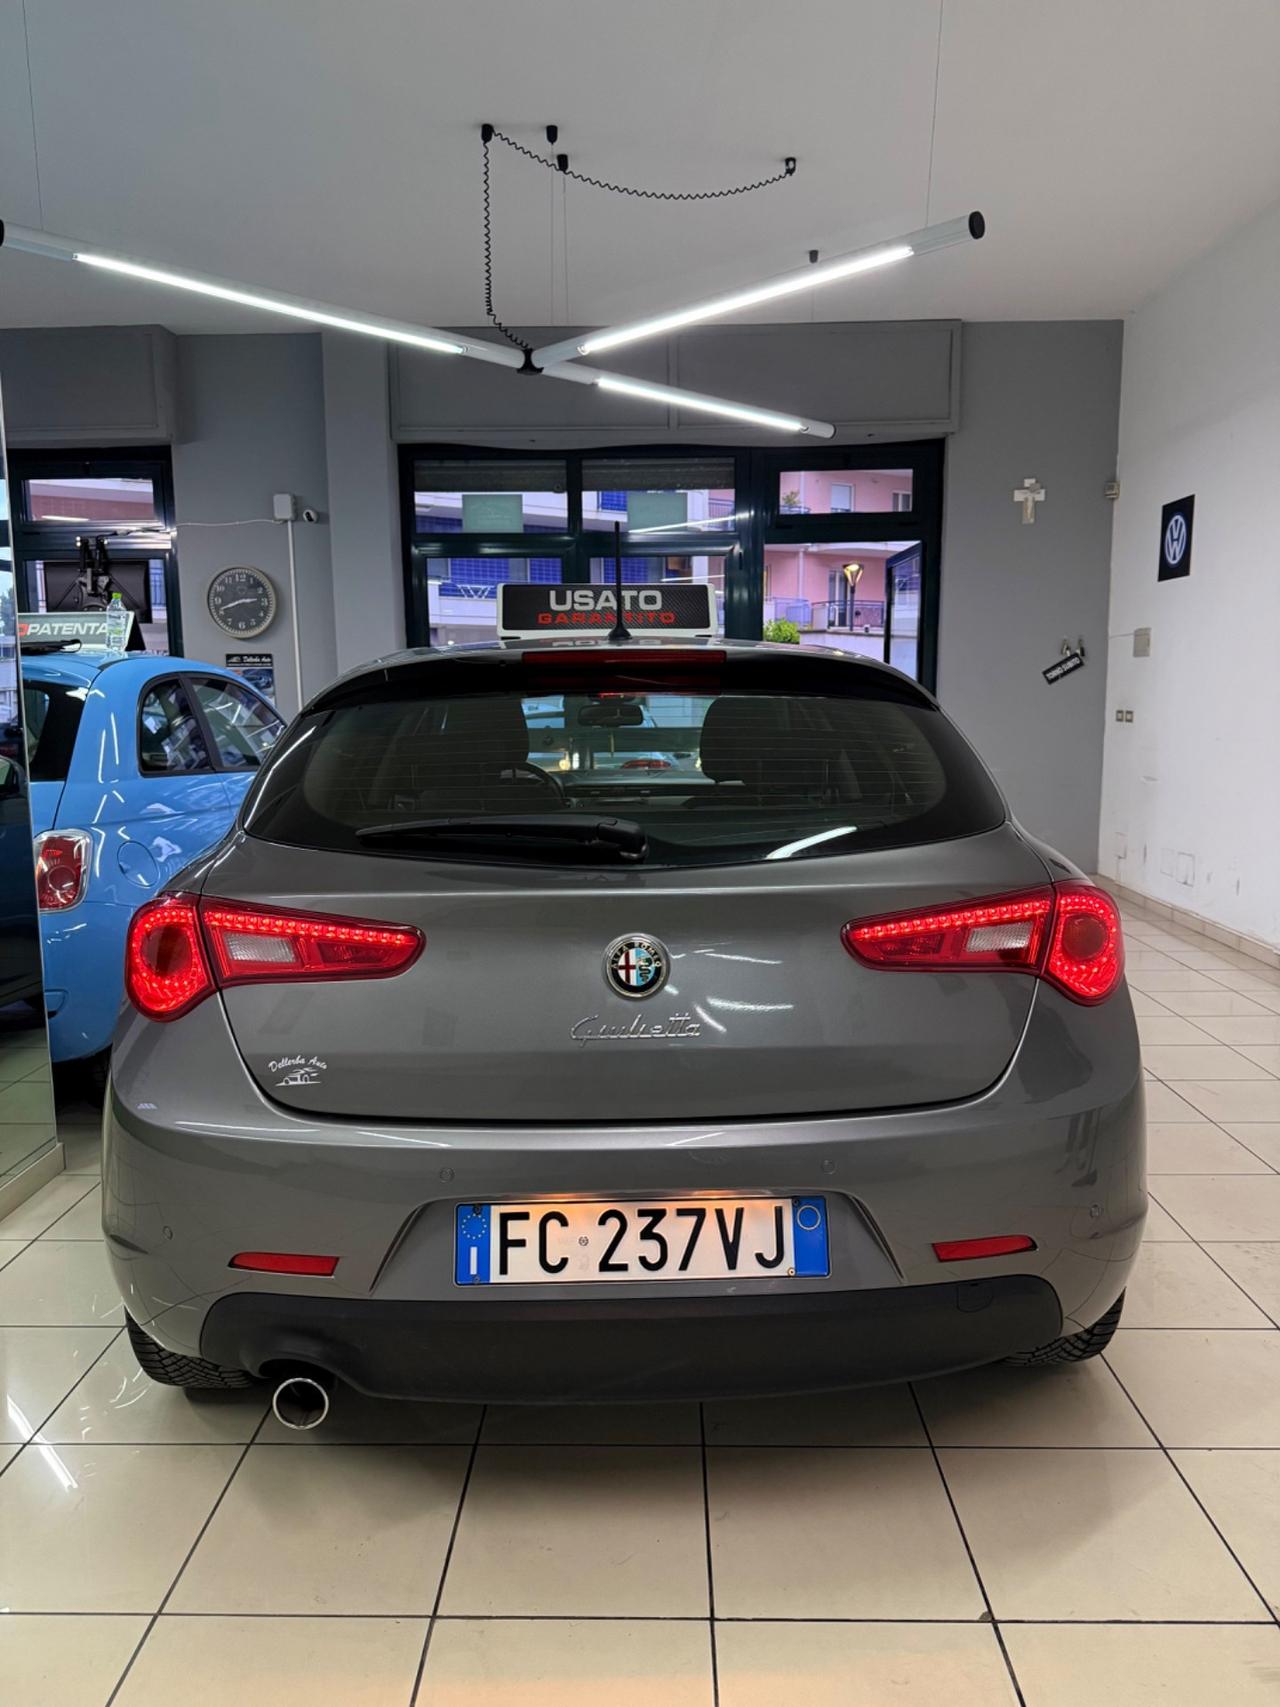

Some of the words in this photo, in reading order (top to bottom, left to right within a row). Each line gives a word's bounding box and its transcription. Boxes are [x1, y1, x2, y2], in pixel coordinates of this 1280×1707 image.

[225, 576, 232, 584] 11
[235, 573, 246, 582] 12
[256, 586, 263, 594] 2
[214, 597, 222, 605] 9
[261, 597, 268, 606] 3
[549, 589, 663, 611] USATO
[537, 611, 677, 625] GARANTITO
[238, 621, 246, 630] 6
[611, 943, 629, 970] ALFA
[633, 941, 663, 968] ROMEO
[570, 1012, 700, 1048] Giulietta
[308, 1056, 328, 1070] Auto
[499, 1209, 569, 1275] FC
[597, 1205, 785, 1274] 237VJ
